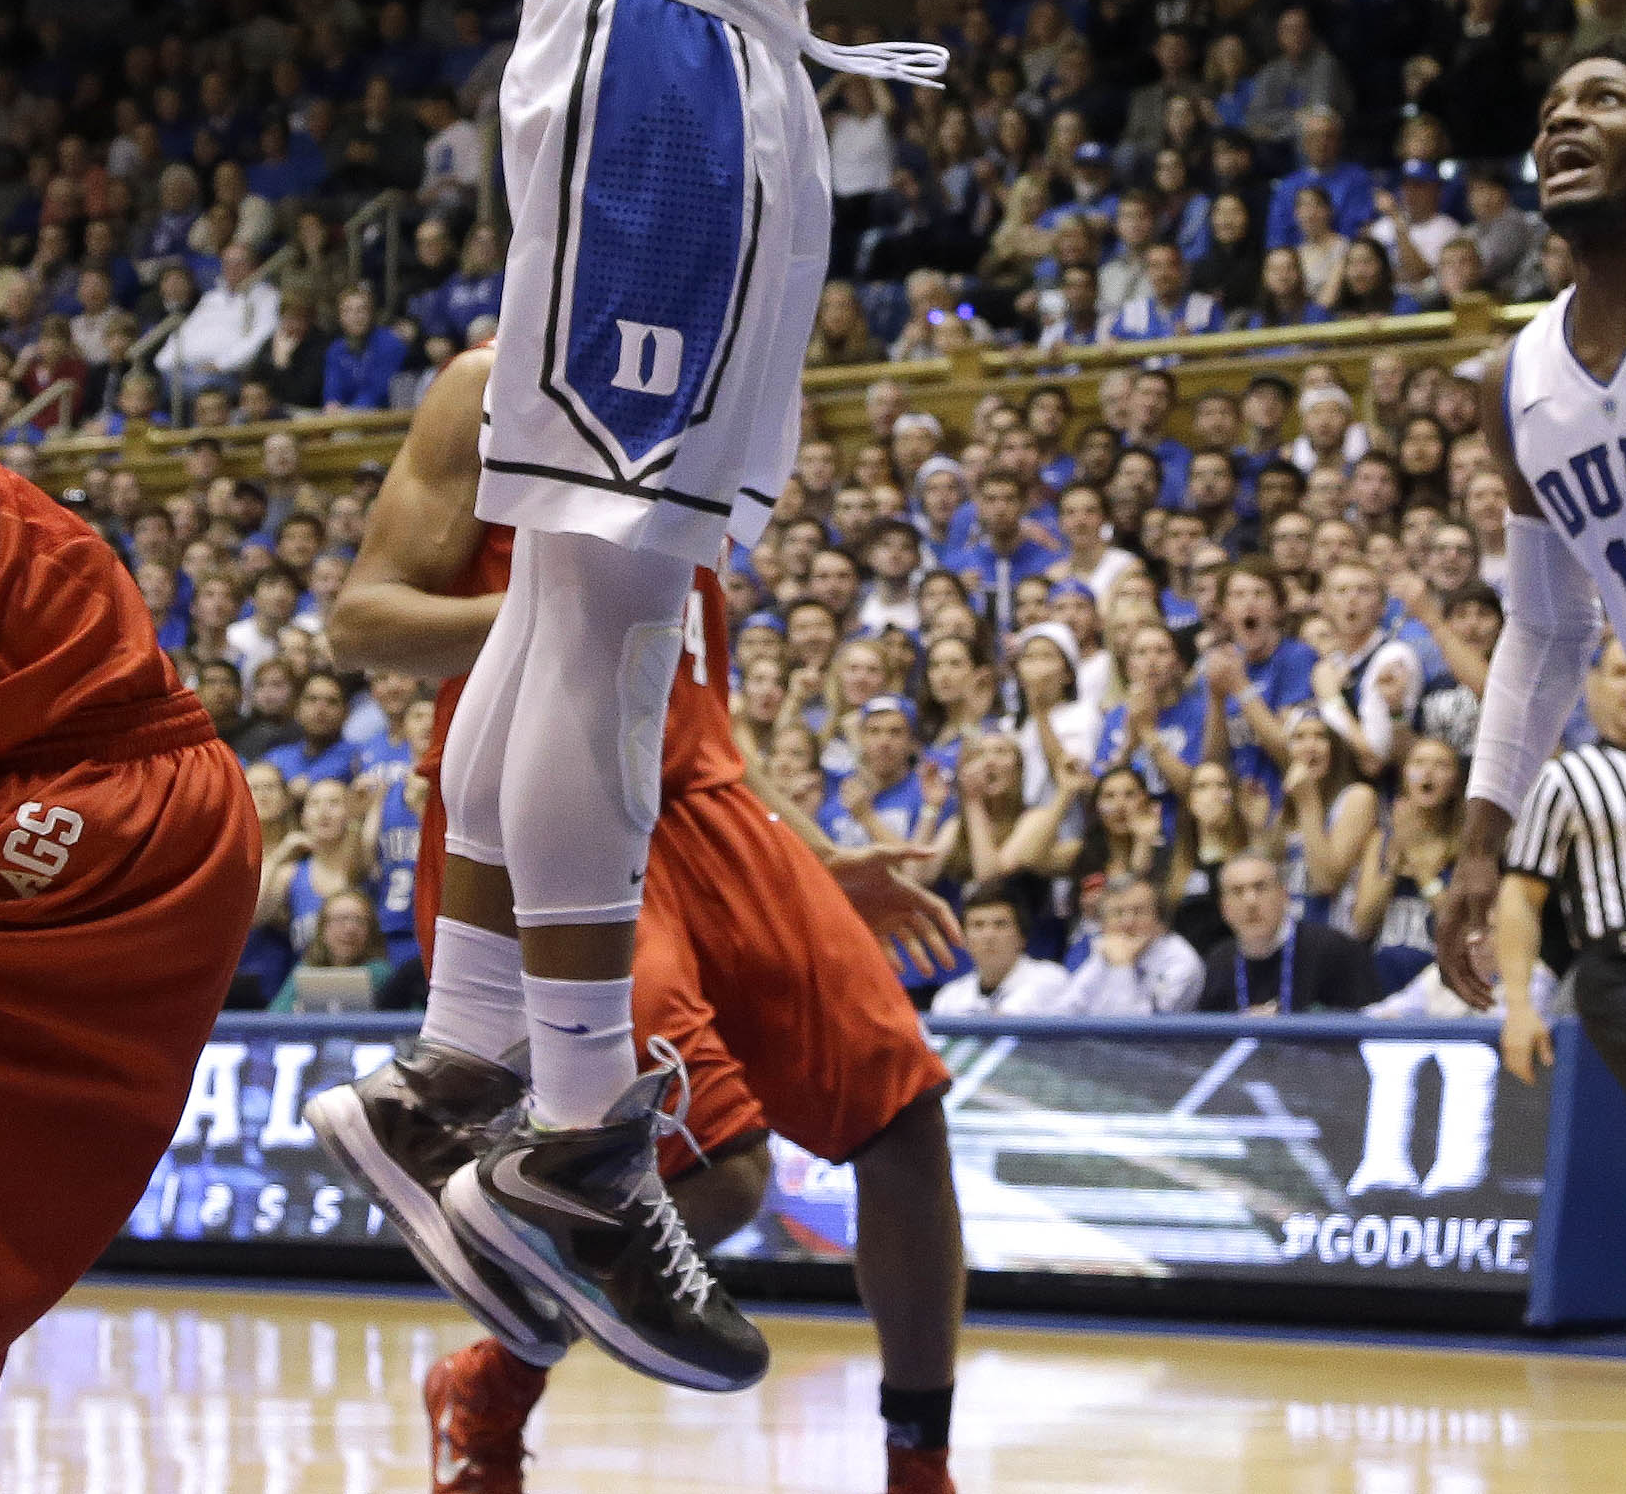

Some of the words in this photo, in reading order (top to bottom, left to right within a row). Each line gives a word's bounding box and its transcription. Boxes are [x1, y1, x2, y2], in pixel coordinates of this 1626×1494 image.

[611, 318, 685, 397] D
[1347, 1040, 1501, 1198] D
[1281, 1212, 1534, 1273] #GODUKE
